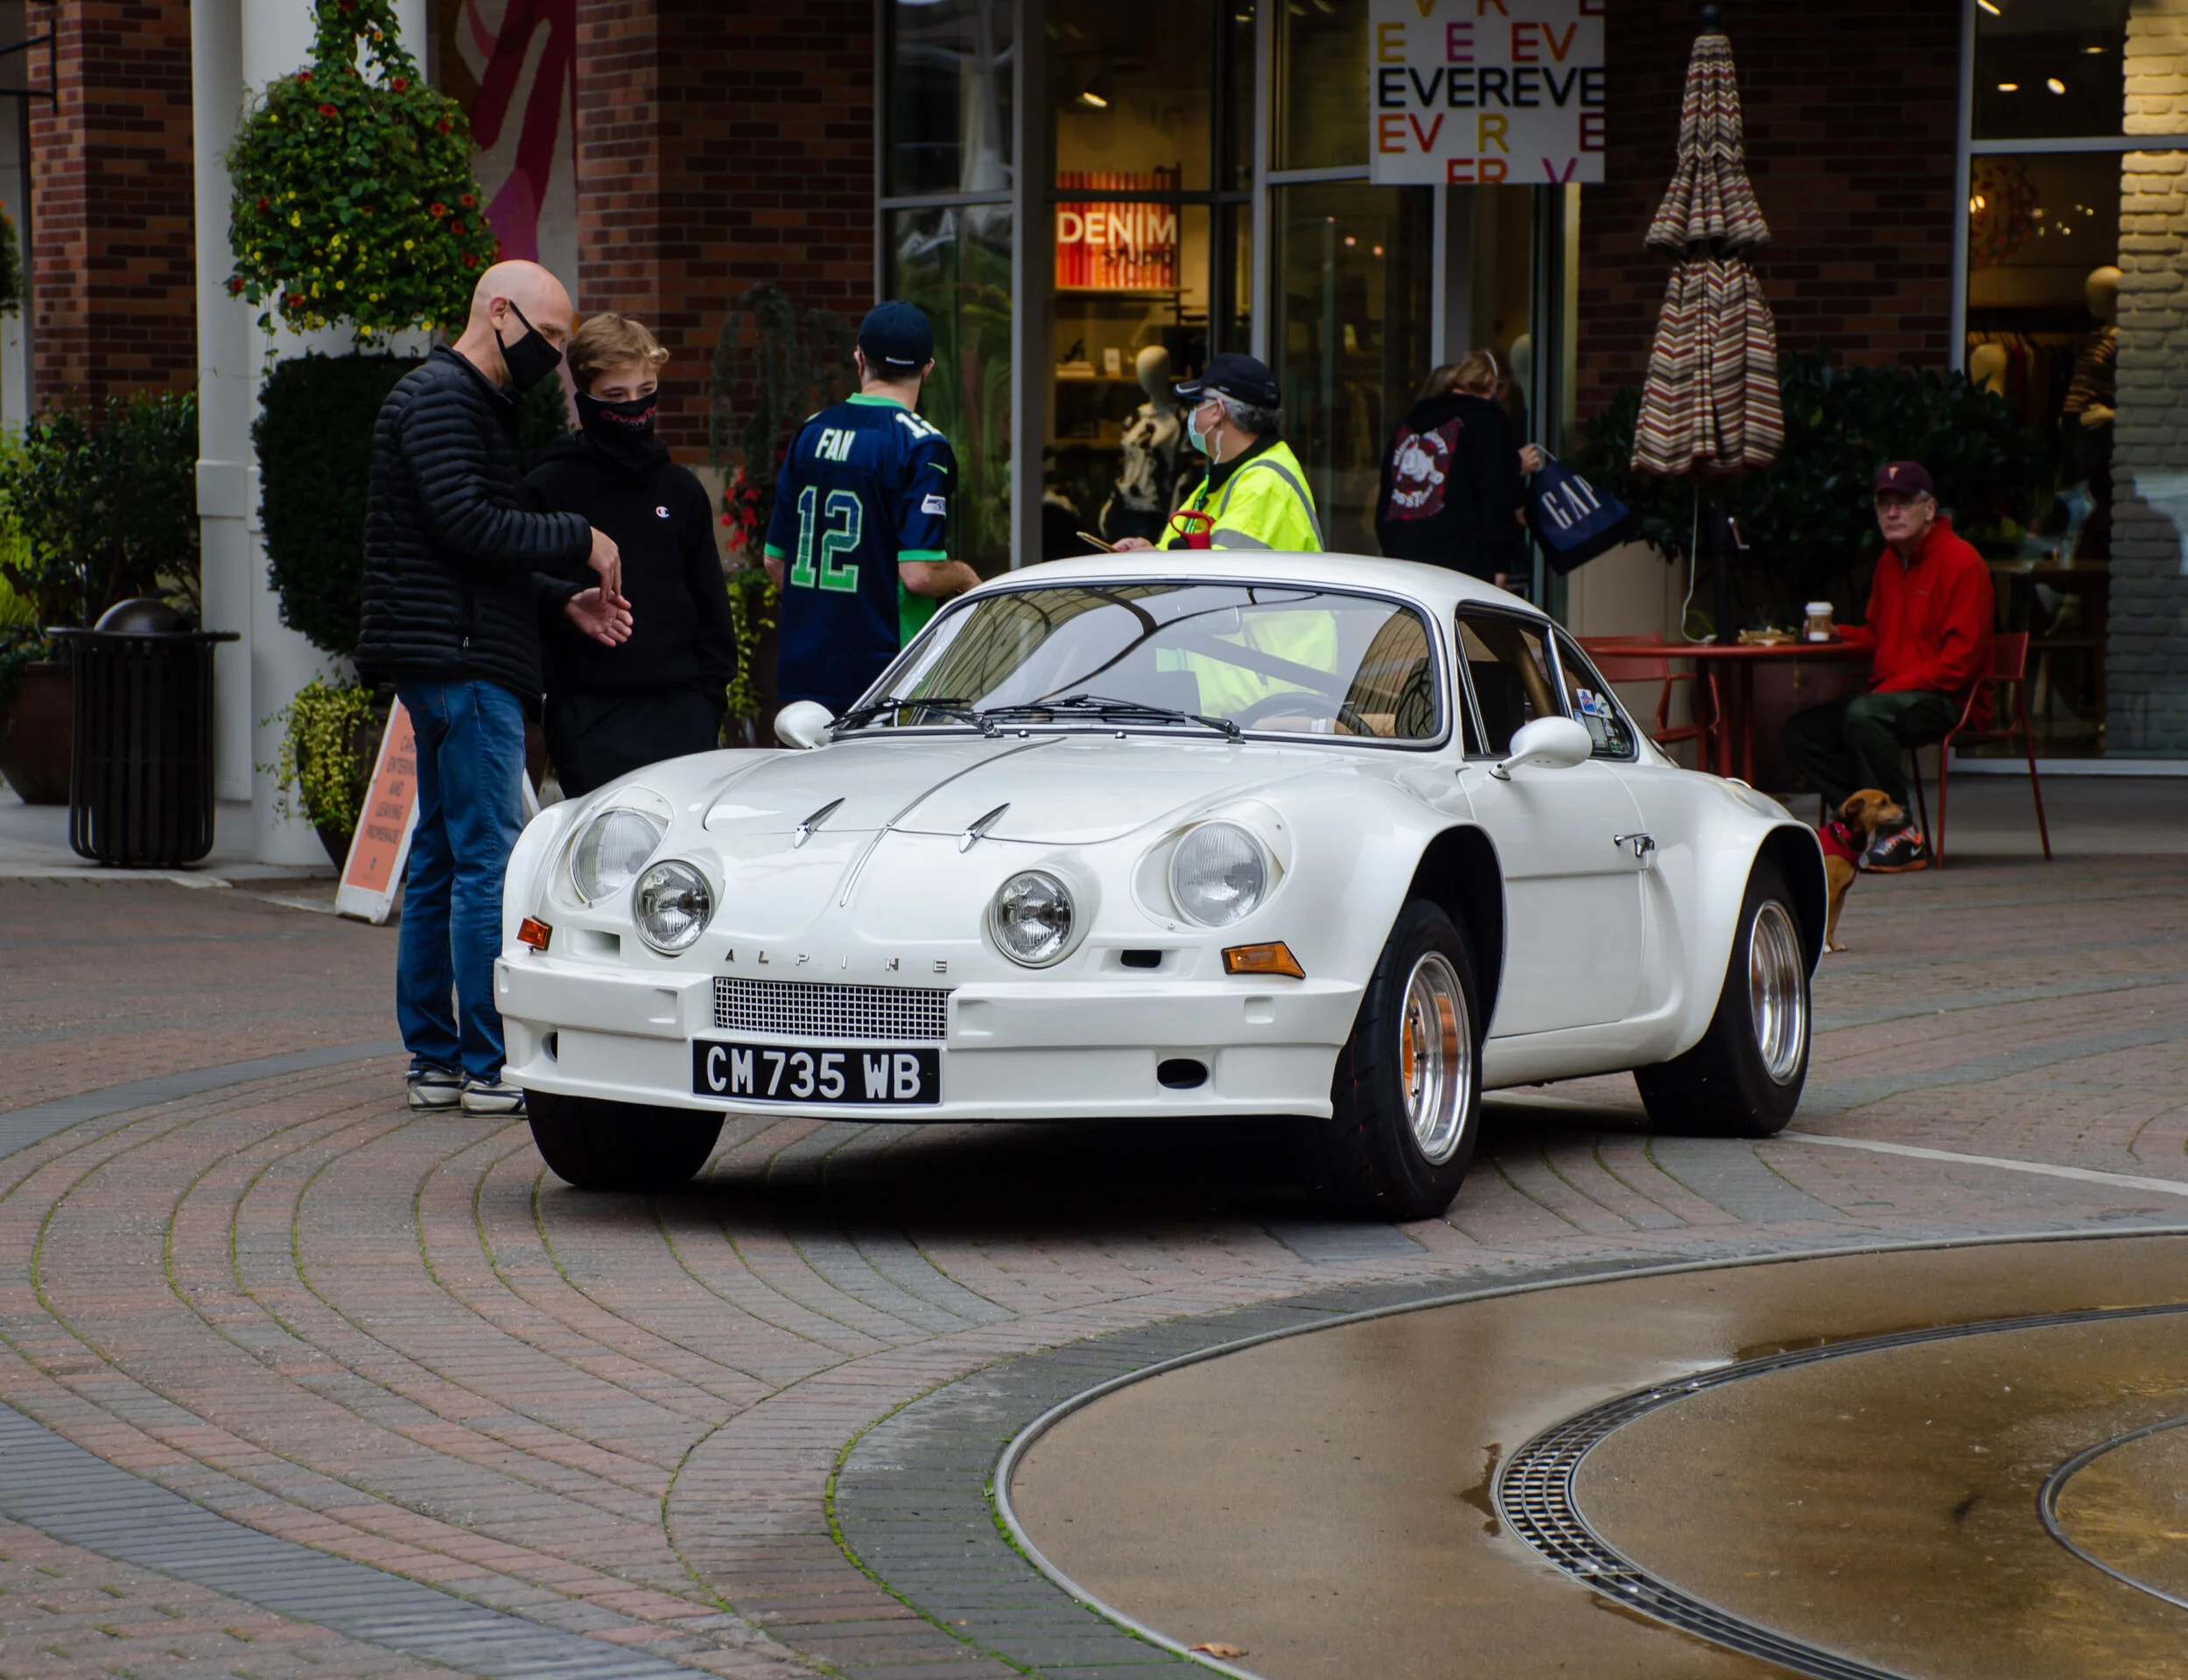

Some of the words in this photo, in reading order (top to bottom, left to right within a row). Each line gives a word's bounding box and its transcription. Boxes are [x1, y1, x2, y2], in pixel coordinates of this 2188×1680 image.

[1378, 67, 1604, 107] EVEREVE
[1378, 113, 1444, 153] EV
[1057, 212, 1176, 244] DENIM
[814, 428, 856, 462] FAN
[1541, 474, 1602, 530] GAP
[790, 485, 863, 593] 12
[725, 948, 948, 973] ALPINE
[706, 1045, 754, 1094] CM
[763, 1051, 845, 1099] 735
[862, 1054, 921, 1099] WB
